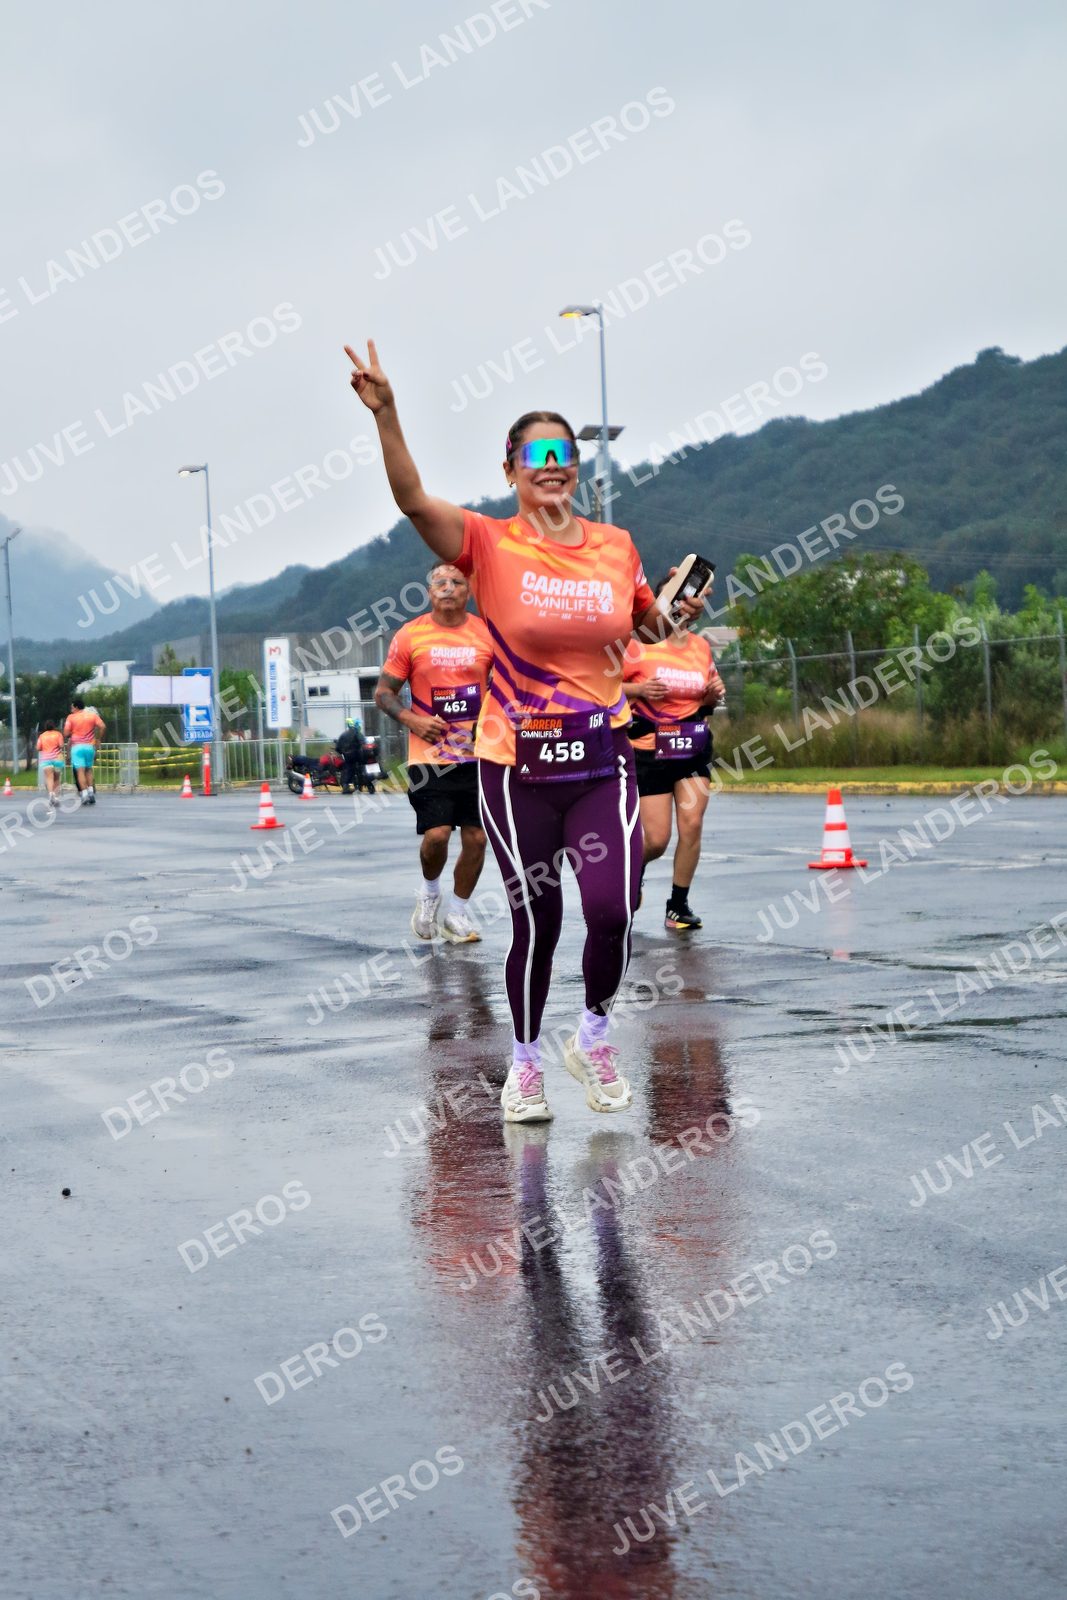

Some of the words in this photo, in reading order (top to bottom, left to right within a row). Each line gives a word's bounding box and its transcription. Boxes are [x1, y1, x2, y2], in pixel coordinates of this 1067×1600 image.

[522, 570, 614, 602] CARRERA
[189, 704, 210, 726] E
[443, 700, 468, 713] 462
[522, 718, 562, 730] CARRERA
[669, 737, 693, 749] 152
[539, 741, 585, 763] 458
